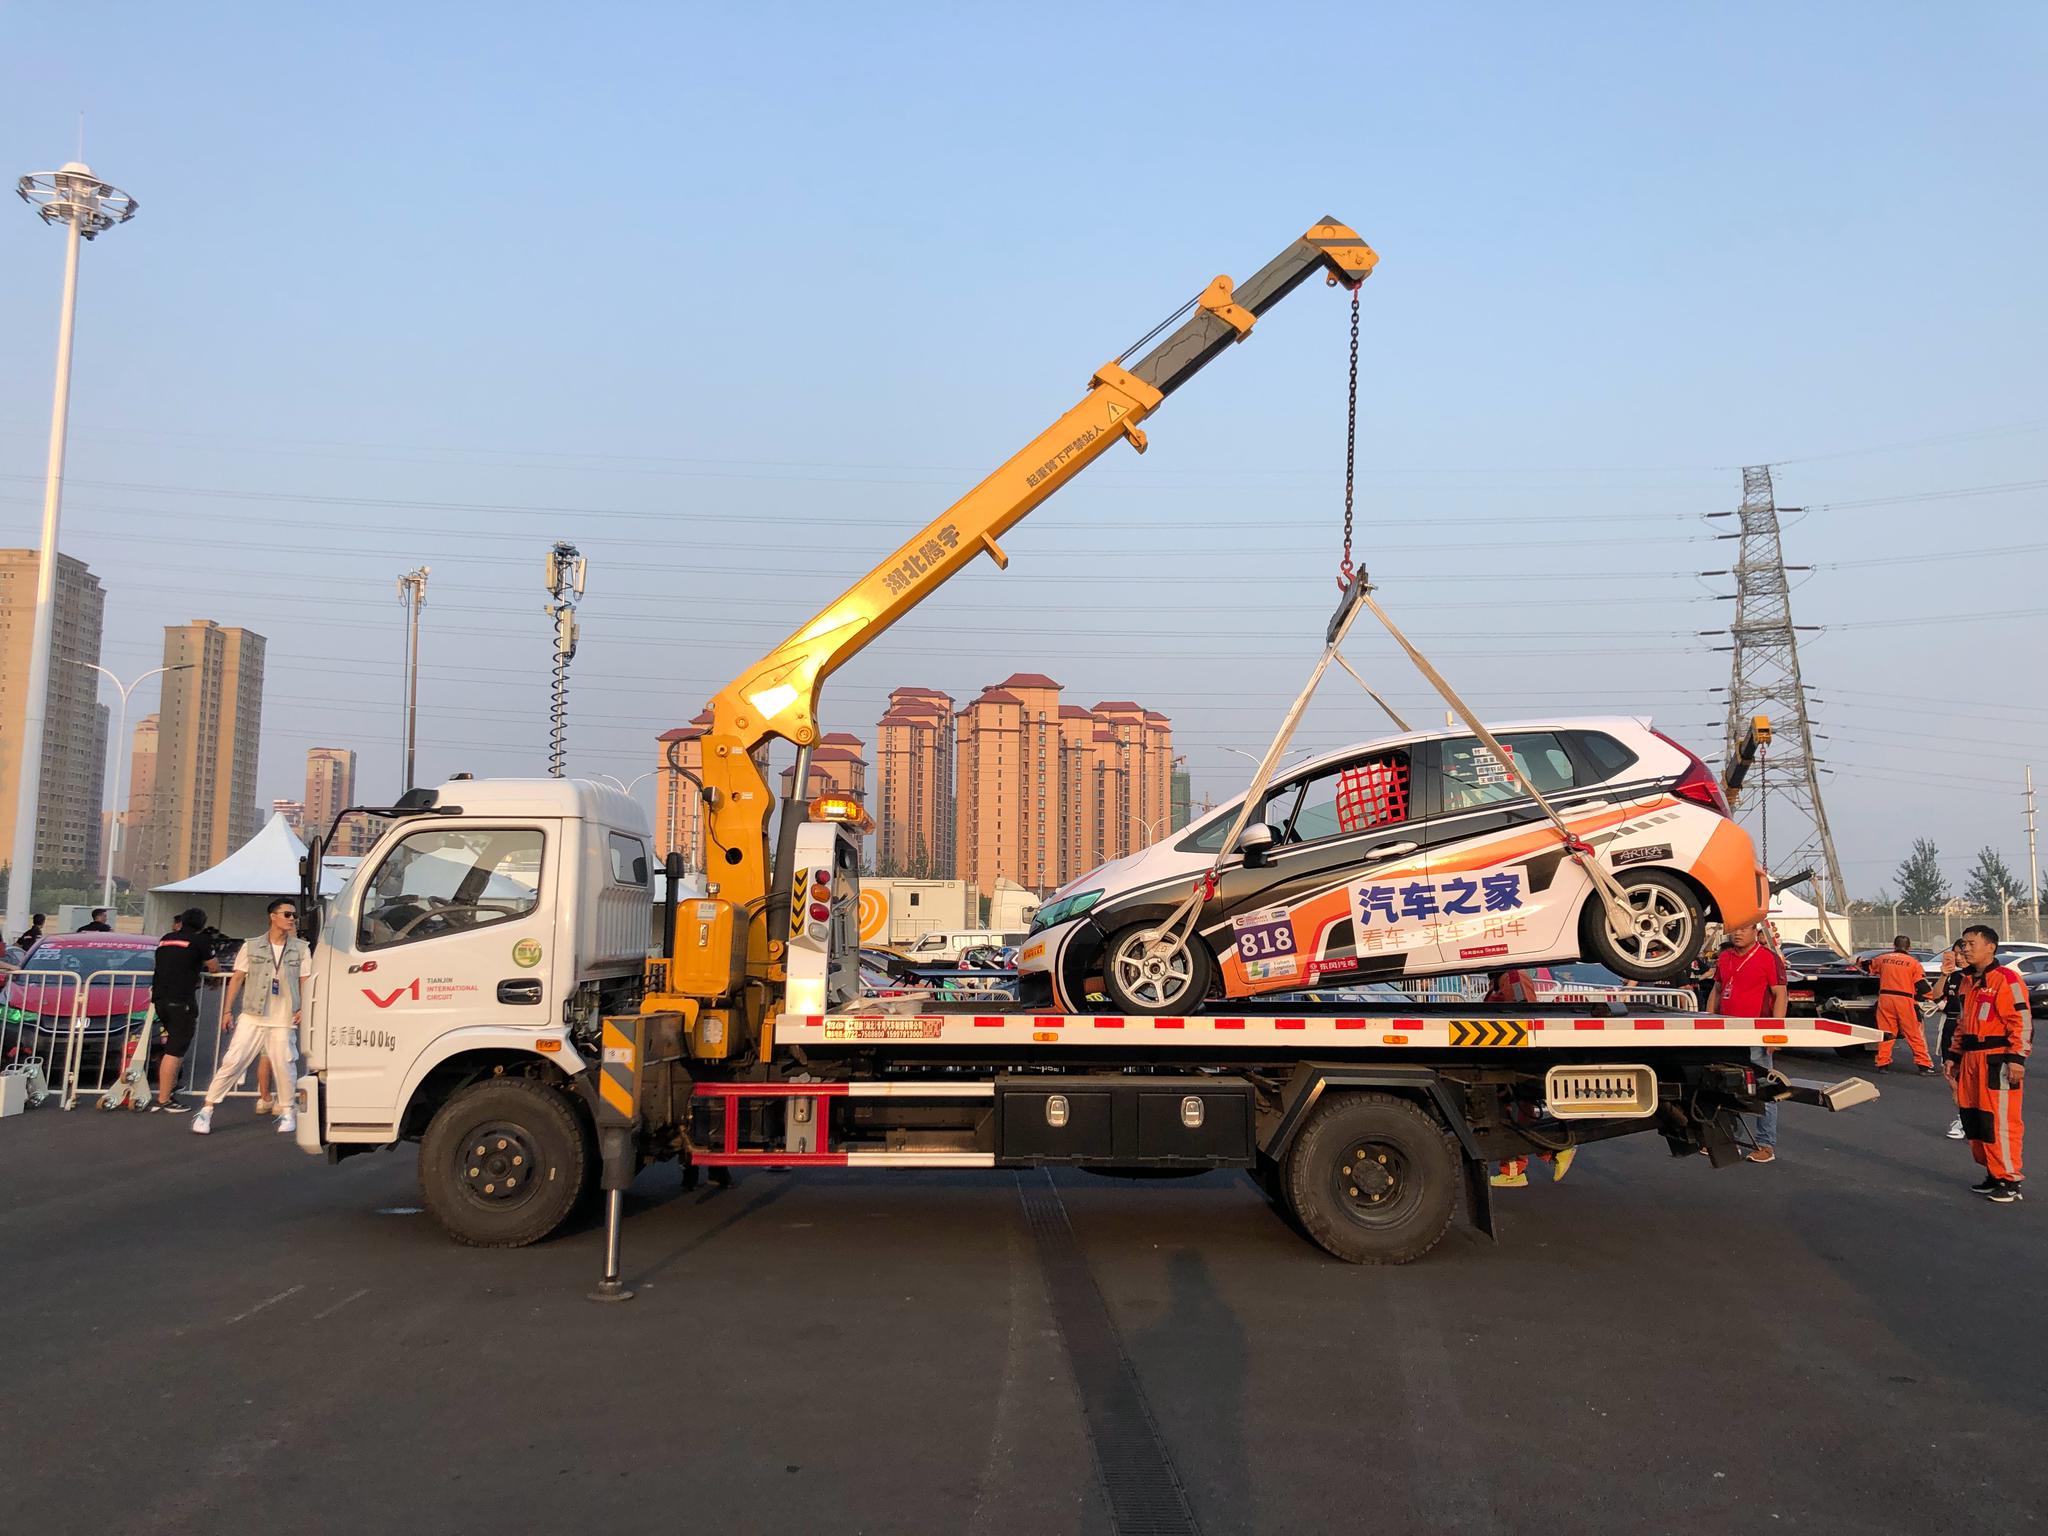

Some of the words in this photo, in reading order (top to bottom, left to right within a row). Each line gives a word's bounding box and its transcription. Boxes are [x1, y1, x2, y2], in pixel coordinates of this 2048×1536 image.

[1026, 425, 1105, 488] 起重臂下严禁站人
[882, 524, 960, 595] 湖北腾宇
[1358, 872, 1523, 926] 汽车之家
[1240, 927, 1292, 957] 818
[426, 985, 479, 993] INTERNATIONAL
